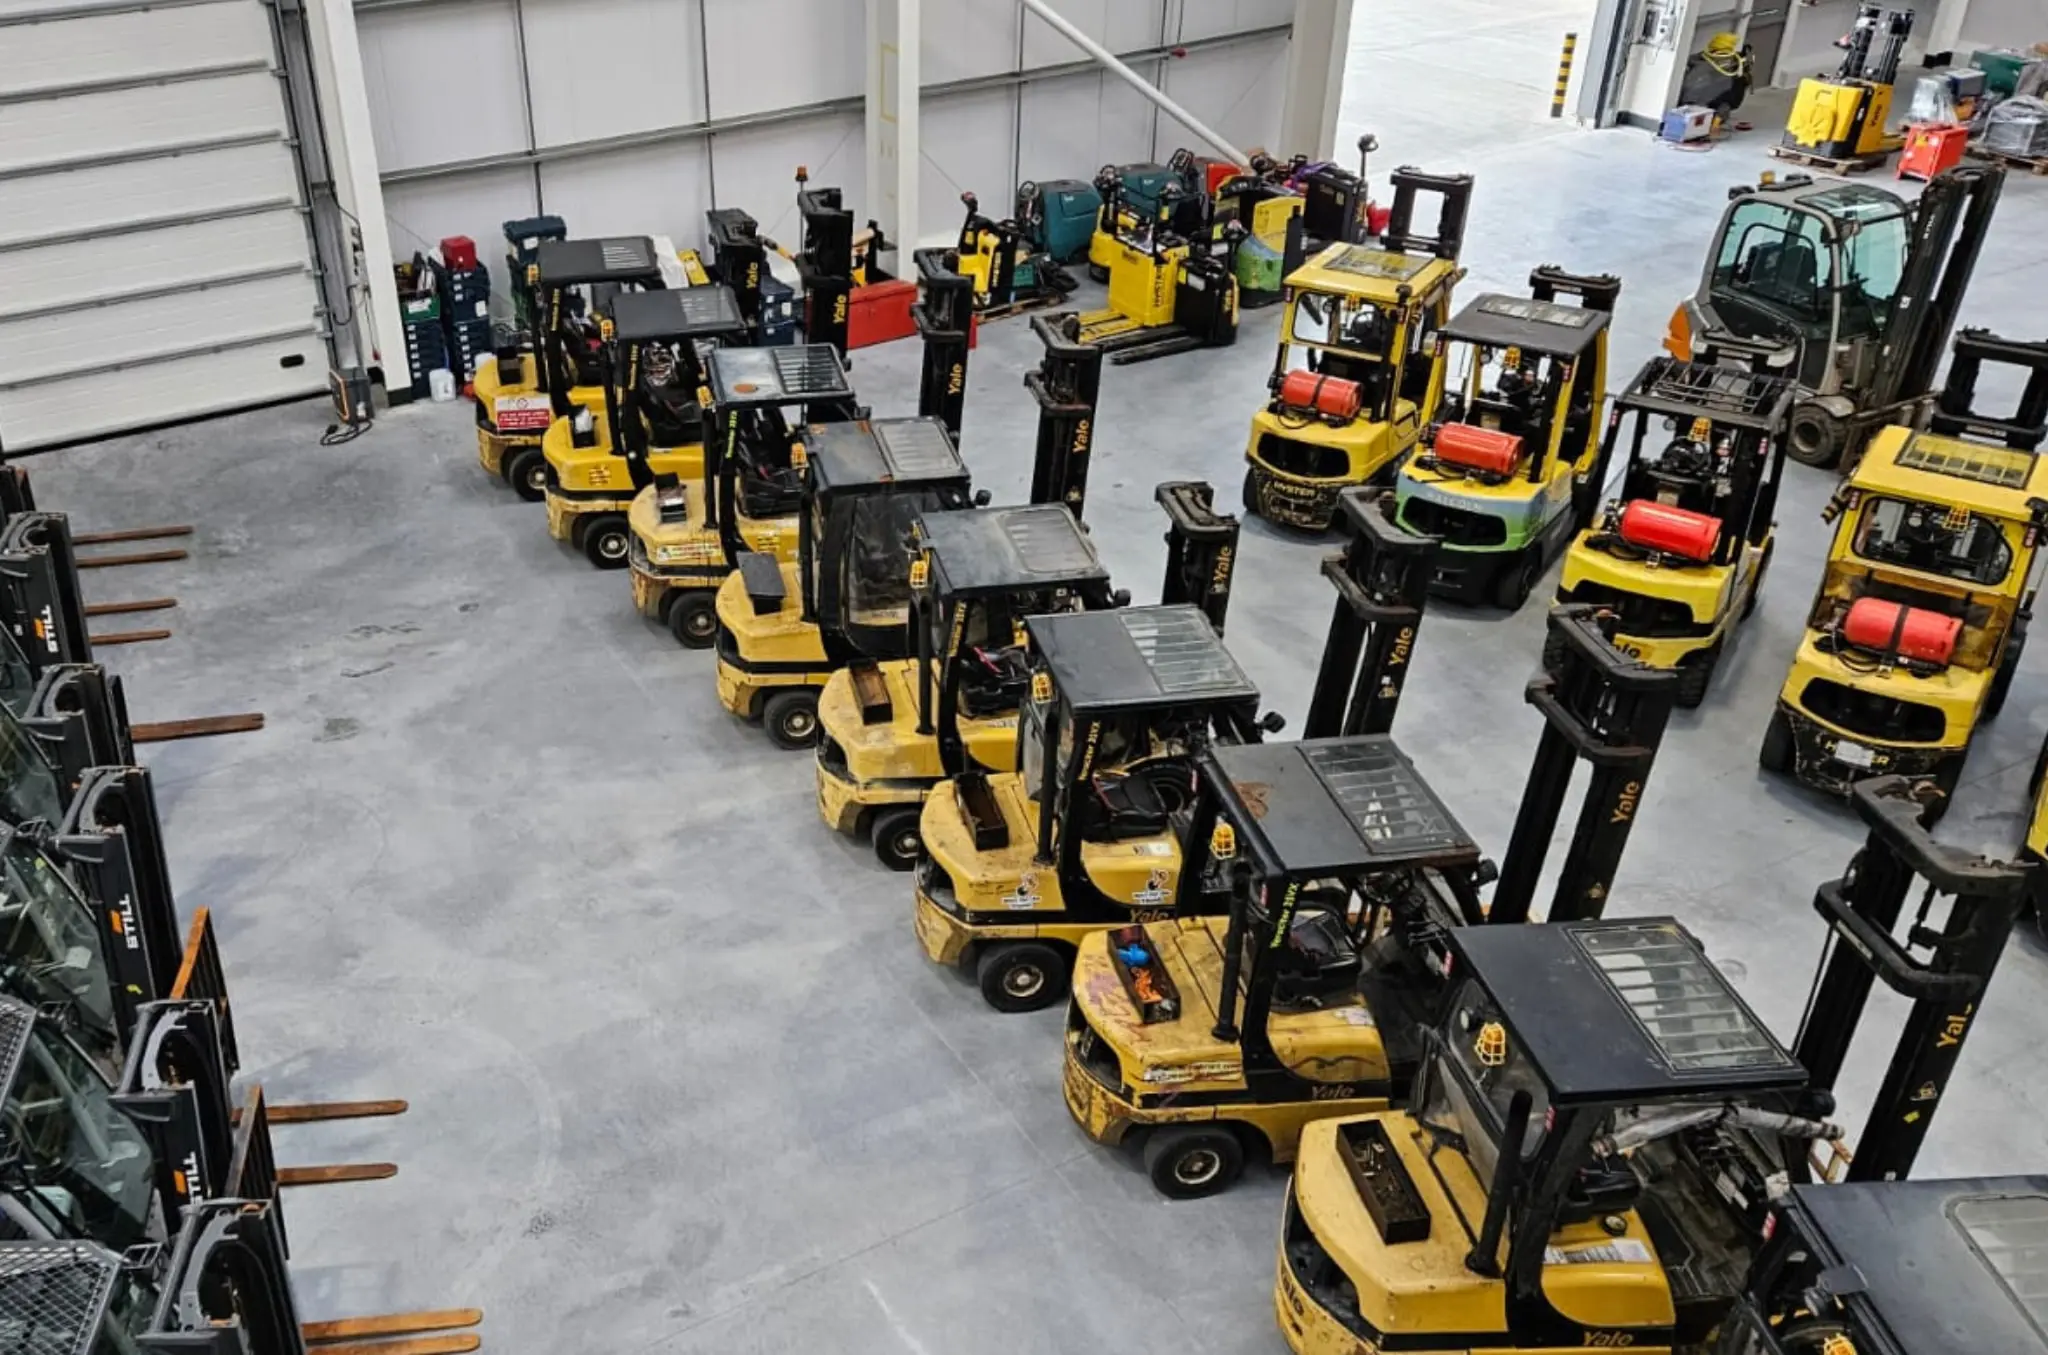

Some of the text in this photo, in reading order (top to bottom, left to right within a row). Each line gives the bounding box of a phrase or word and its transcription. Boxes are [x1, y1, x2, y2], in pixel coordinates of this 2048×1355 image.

[745, 261, 759, 289] Yale
[832, 294, 847, 324] Yale
[948, 363, 963, 395] Yale
[1072, 419, 1090, 453] Yale
[1213, 545, 1232, 582] Yale
[41, 604, 59, 653] STILL
[1388, 627, 1413, 666] Yale
[1825, 741, 1890, 766] HER
[1610, 781, 1639, 823] Yale
[119, 893, 140, 949] STILL
[1129, 909, 1169, 923] Yale
[1311, 1084, 1355, 1100] Yale
[183, 1151, 204, 1205] STILL
[1582, 1331, 1635, 1347] Yale
